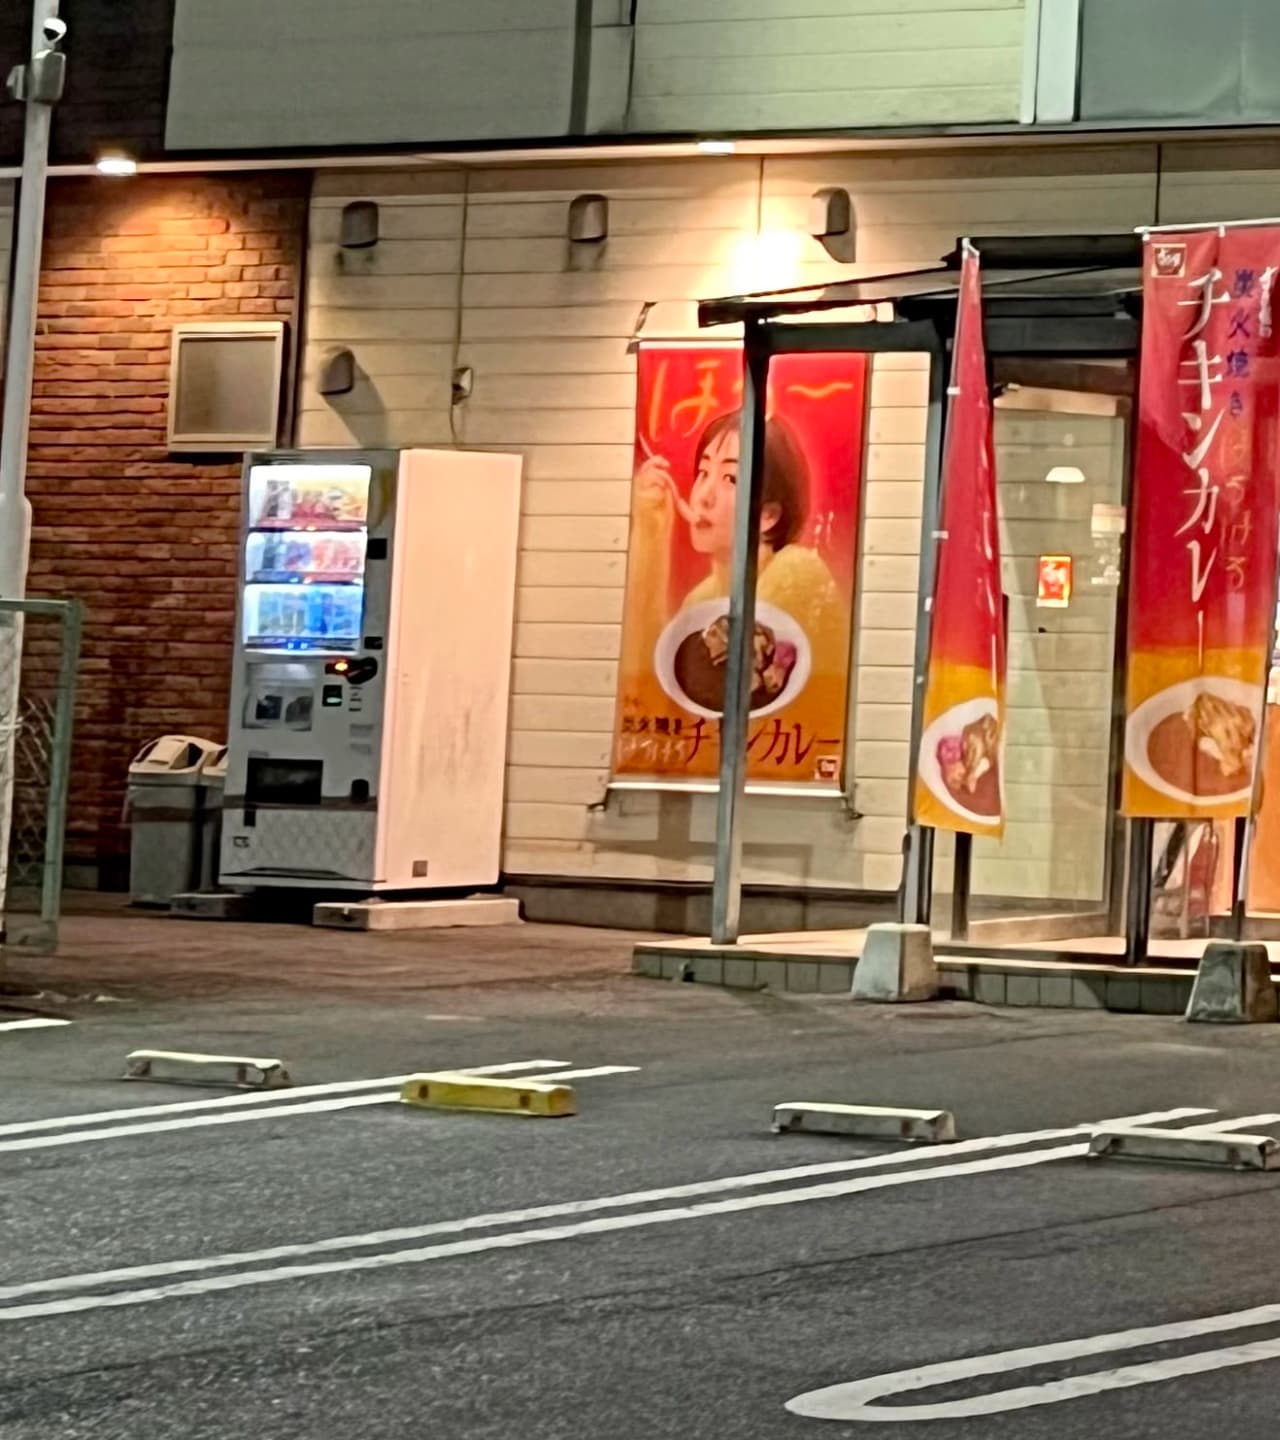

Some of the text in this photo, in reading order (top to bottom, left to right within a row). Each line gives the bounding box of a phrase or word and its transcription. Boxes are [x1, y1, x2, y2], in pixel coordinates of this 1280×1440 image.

[1175, 267, 1231, 670] チキンカレー
